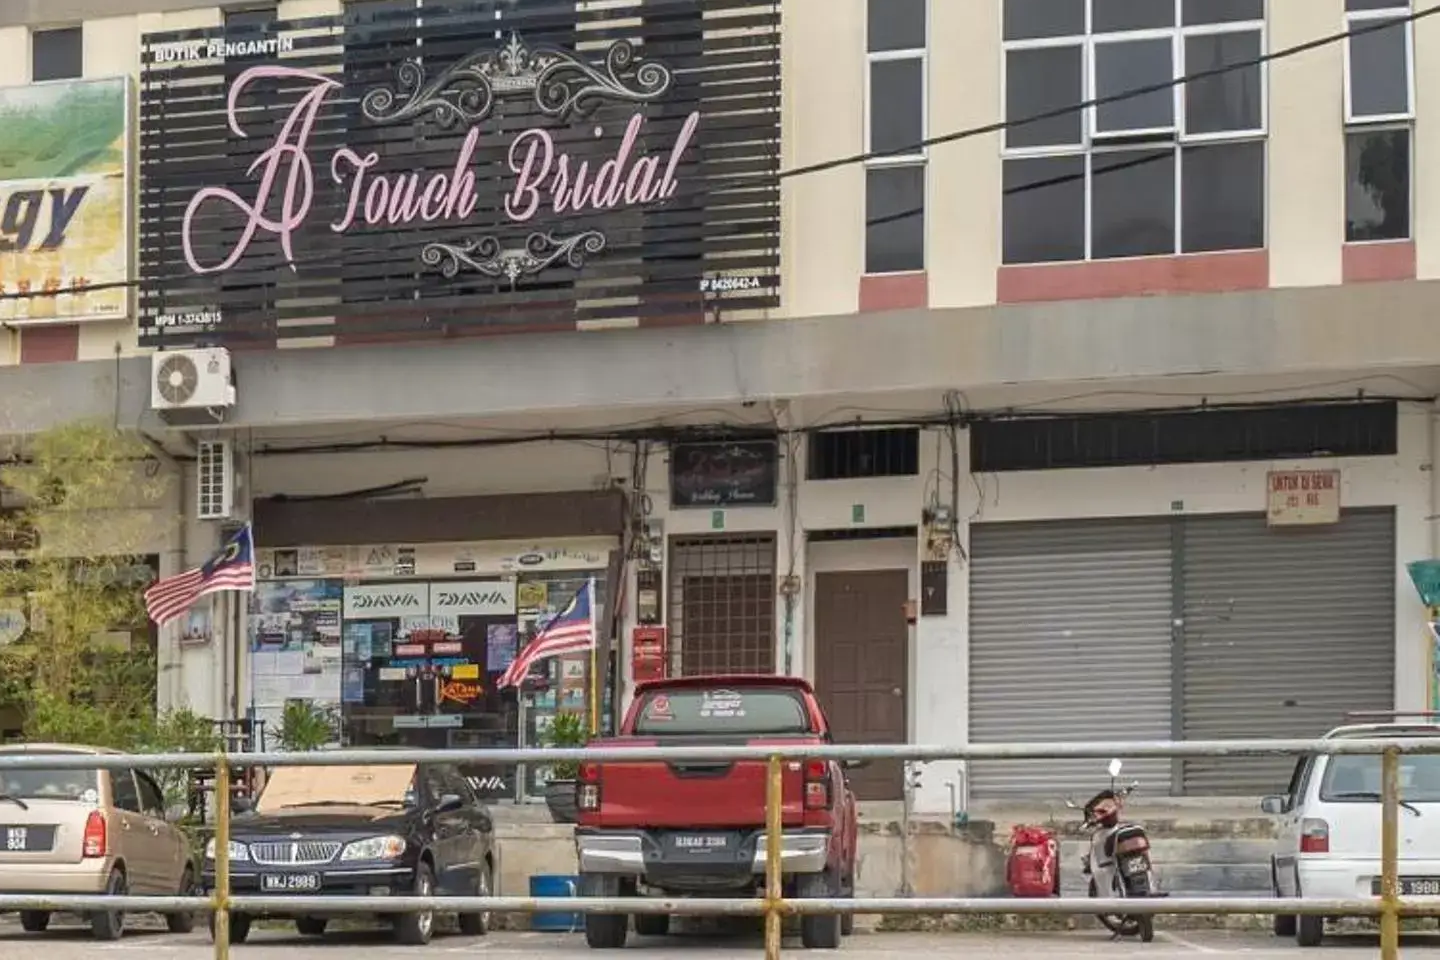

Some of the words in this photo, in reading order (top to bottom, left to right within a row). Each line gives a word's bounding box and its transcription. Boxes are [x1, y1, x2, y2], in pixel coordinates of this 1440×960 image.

[154, 45, 201, 62] BUTIK
[206, 37, 294, 58] PENGANTIN
[182, 64, 344, 275] A
[330, 125, 481, 234] Touch
[503, 110, 700, 222] Bridal
[351, 592, 420, 609] DAIWA
[436, 590, 508, 607] DAIWA
